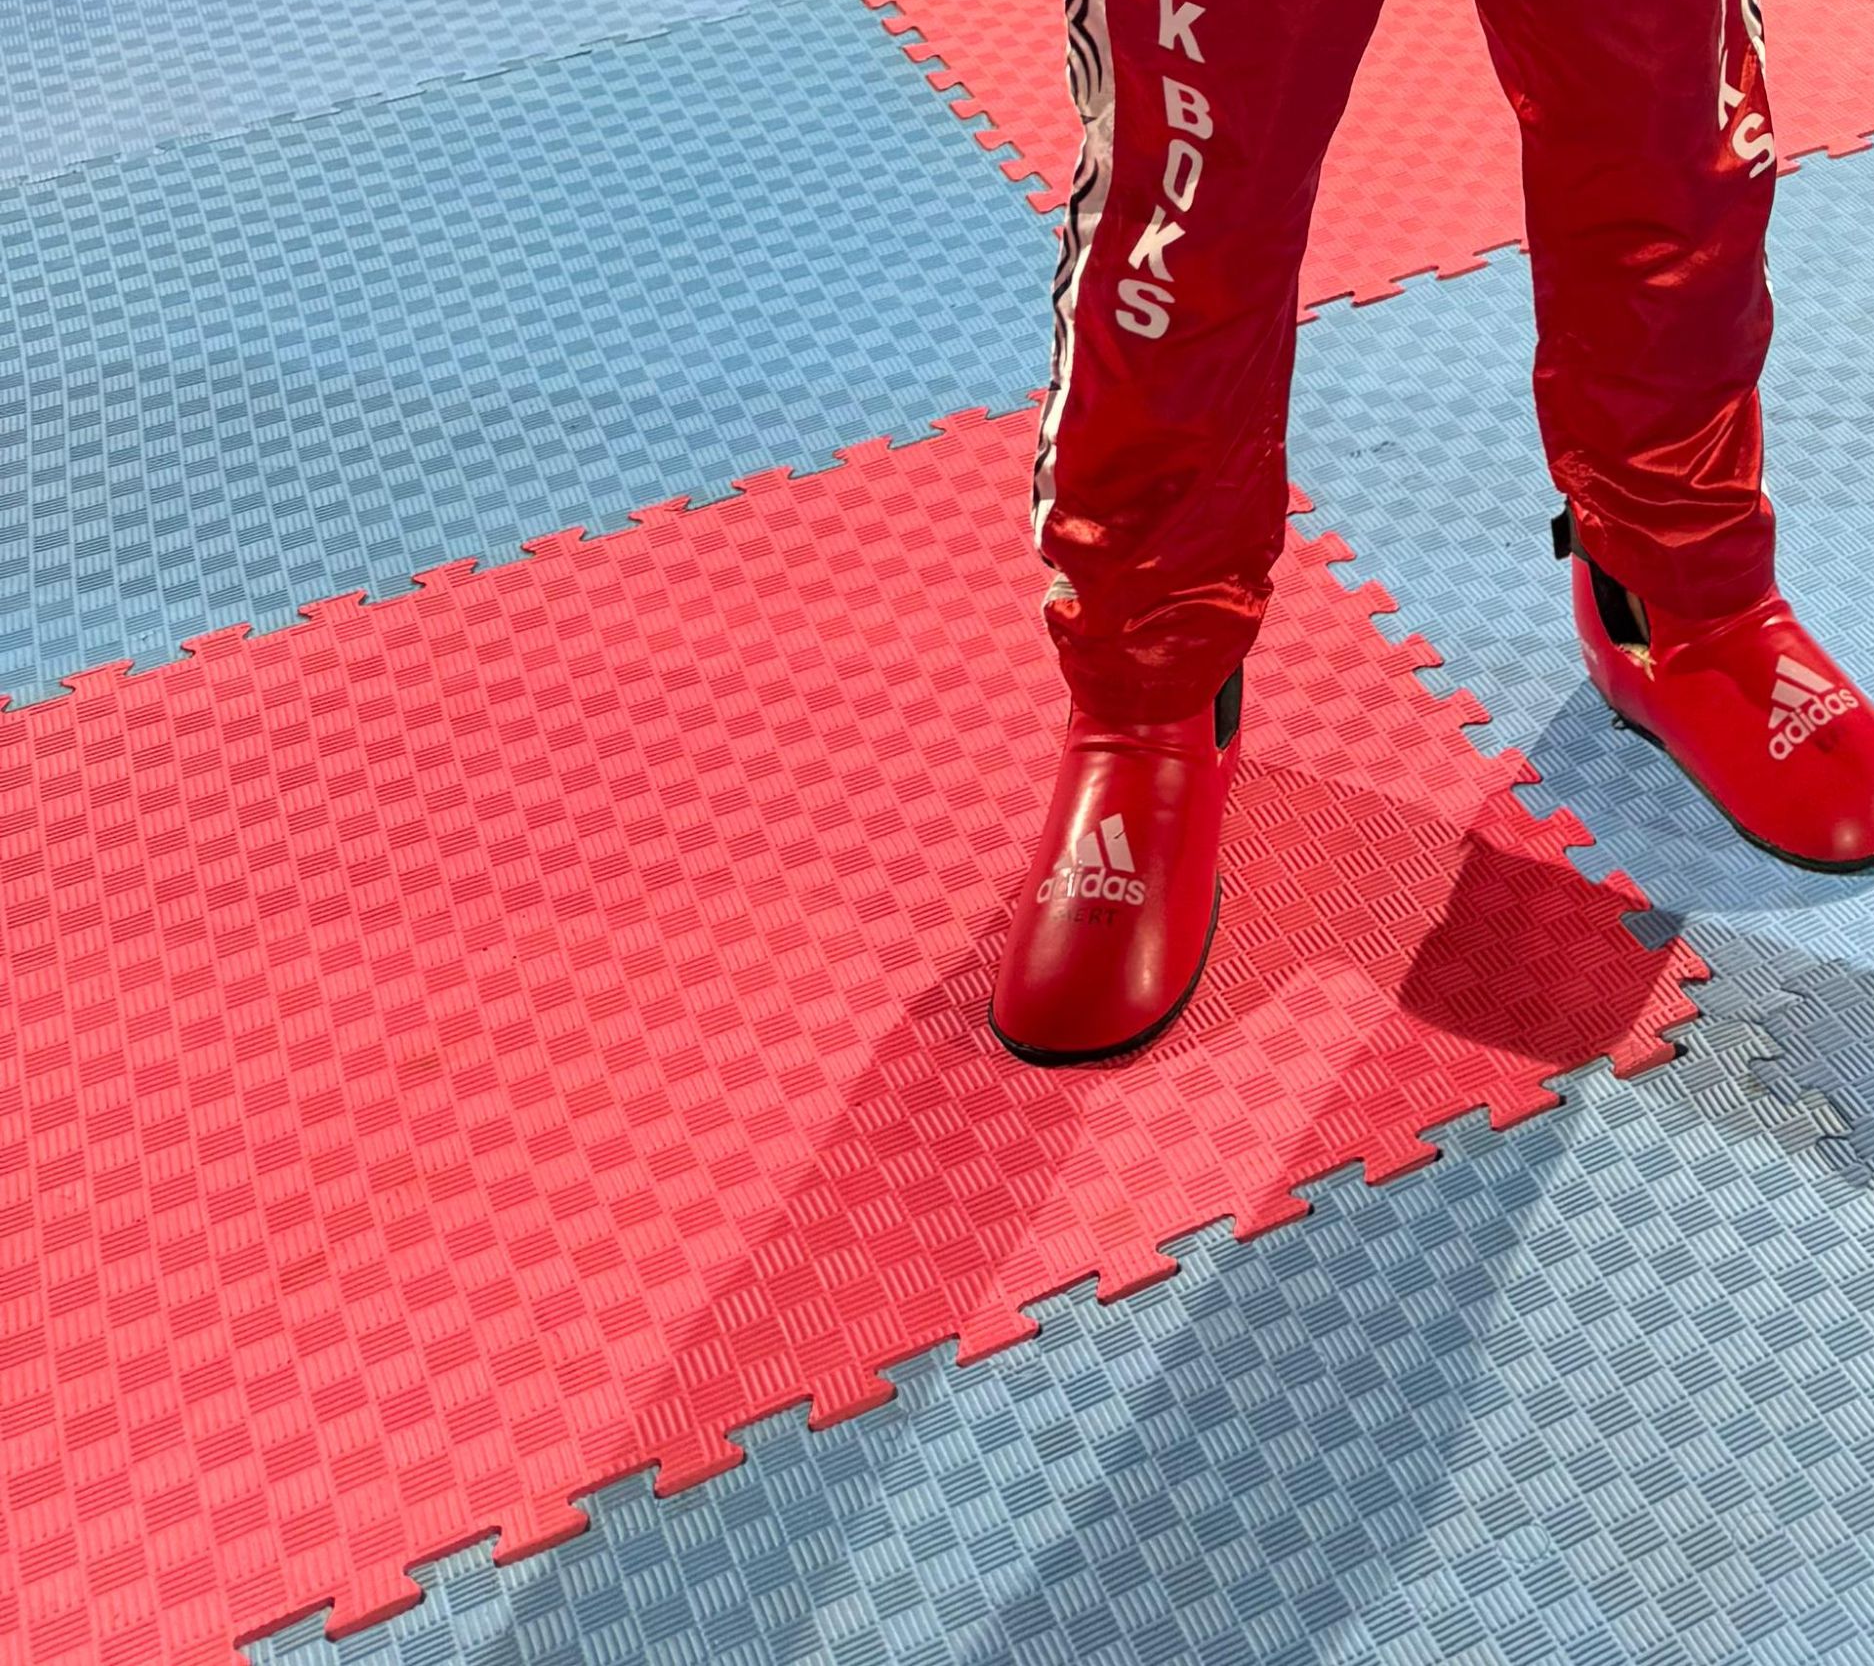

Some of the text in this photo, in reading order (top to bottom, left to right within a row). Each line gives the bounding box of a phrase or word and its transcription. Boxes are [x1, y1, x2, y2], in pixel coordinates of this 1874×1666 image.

[1114, 75, 1215, 341] BOKS
[1767, 688, 1861, 761] adidas
[1036, 867, 1148, 906] adidas
